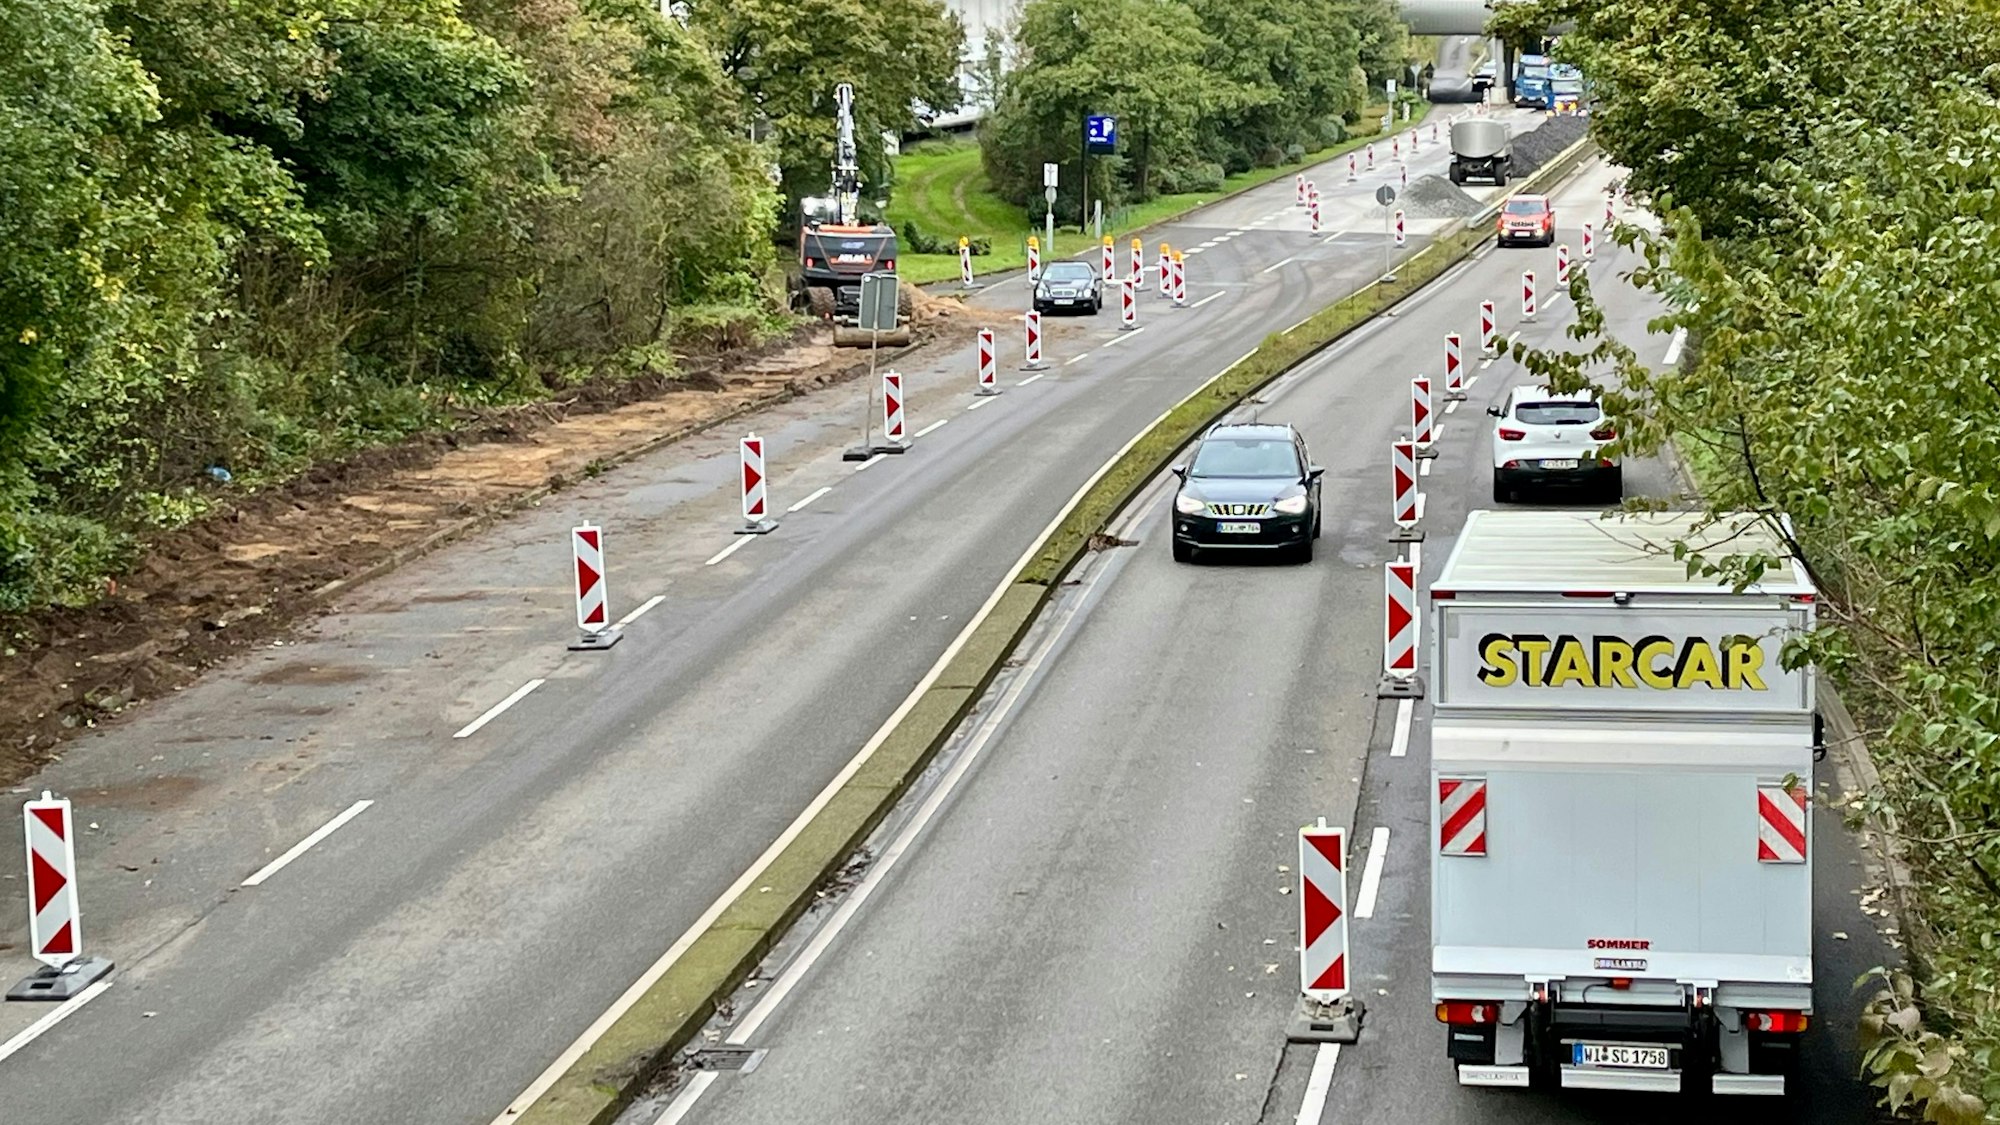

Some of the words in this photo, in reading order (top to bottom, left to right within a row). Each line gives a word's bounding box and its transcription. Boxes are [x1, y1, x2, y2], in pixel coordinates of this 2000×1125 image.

[1477, 633, 1768, 690] STARCAR
[1587, 939, 1650, 950] SOMMER
[1584, 1048, 1601, 1063] WI
[1612, 1049, 1630, 1064] SC
[1632, 1050, 1666, 1066] 1758
